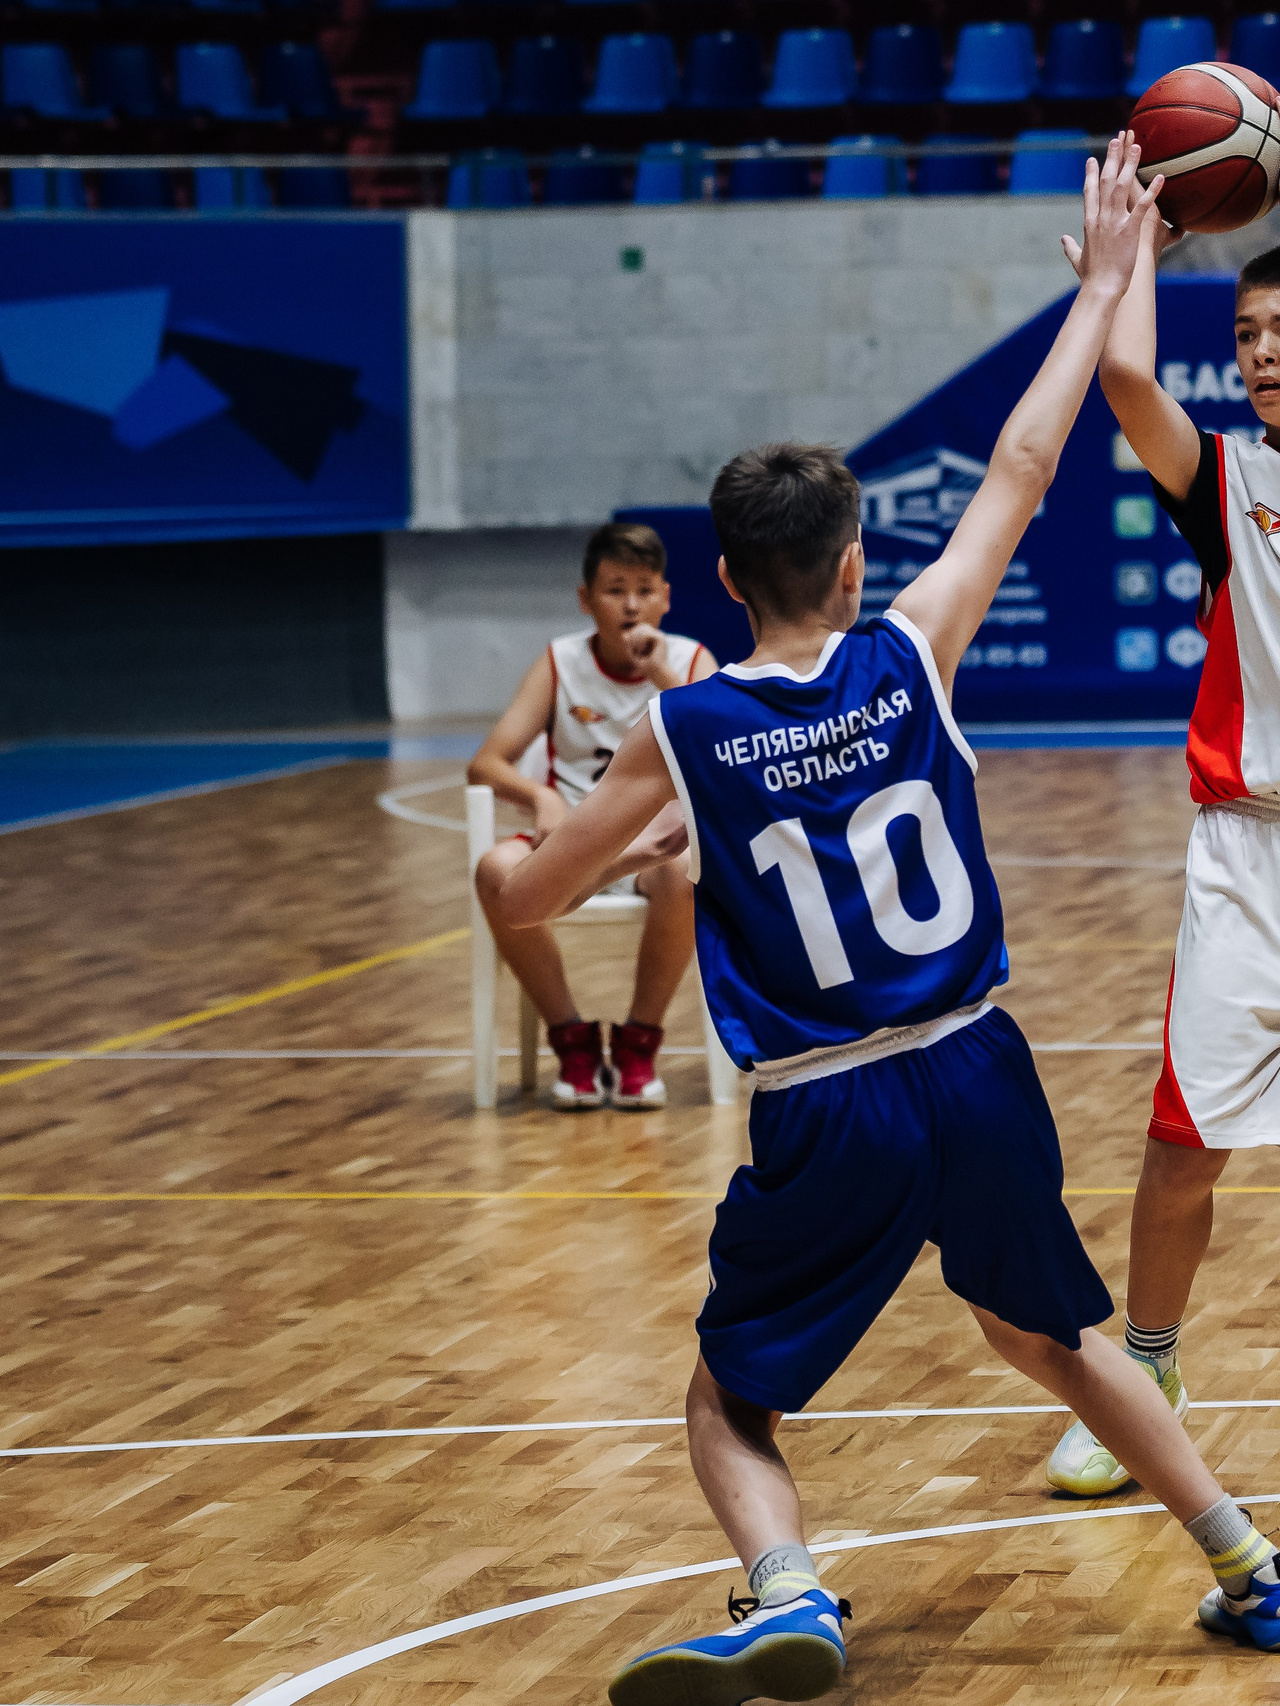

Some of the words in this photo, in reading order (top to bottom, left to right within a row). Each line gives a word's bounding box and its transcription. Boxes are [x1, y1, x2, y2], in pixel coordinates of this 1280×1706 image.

[714, 688, 913, 767] ЧЕЛЯБИНСКАЯ
[763, 736, 890, 792] ОБЛАСТЬ
[749, 779, 974, 989] 10
